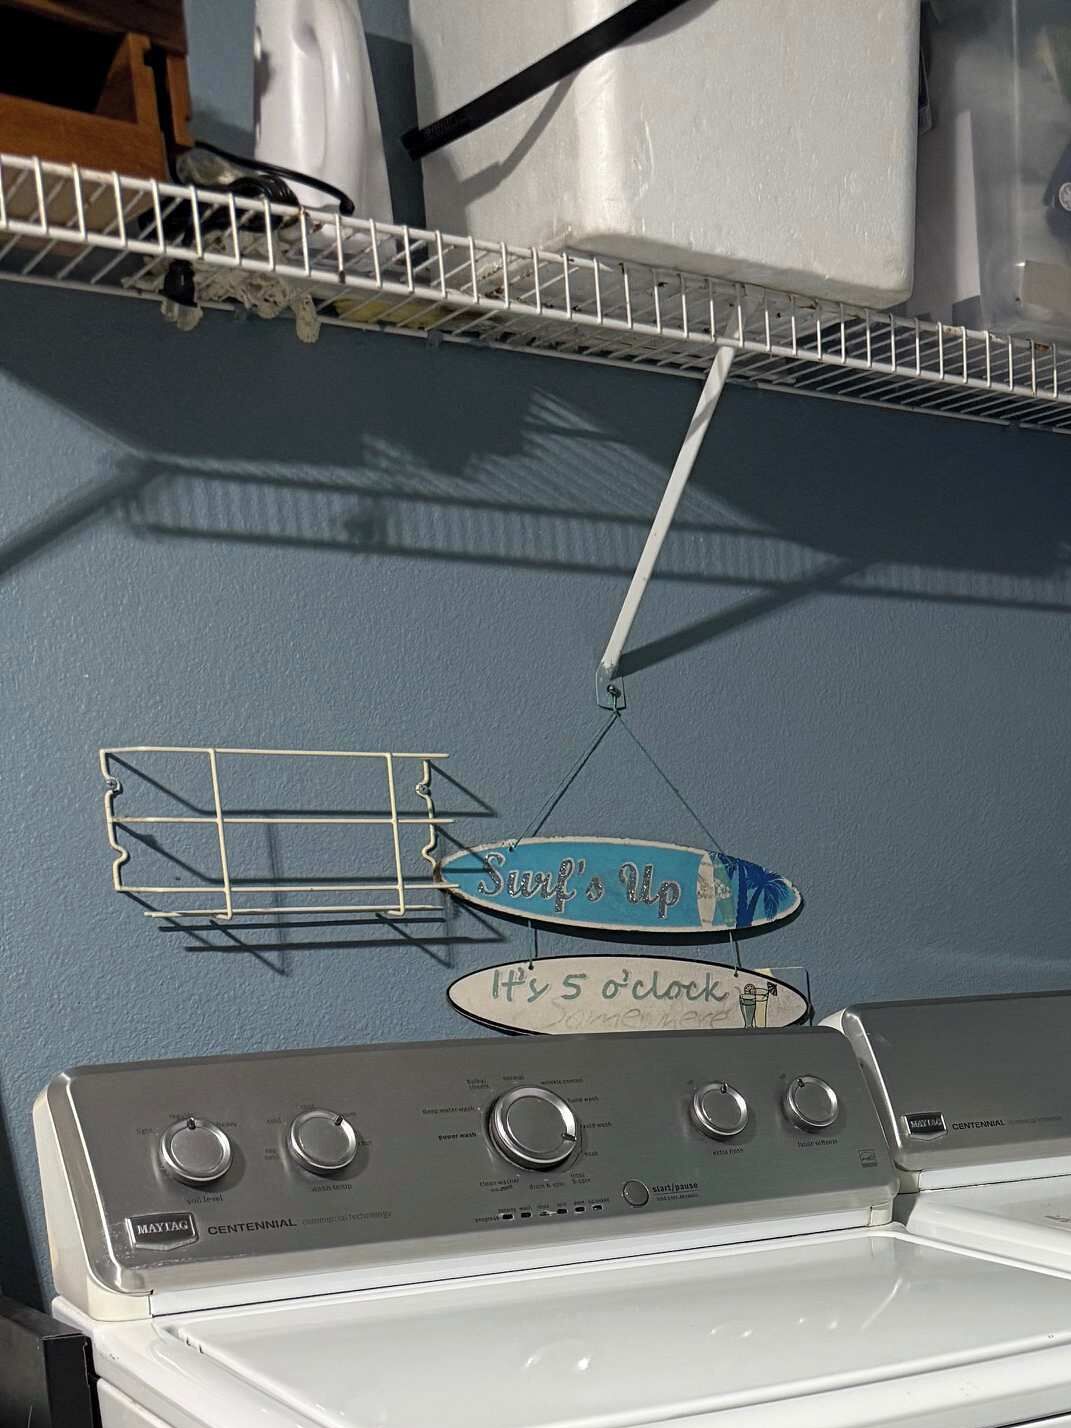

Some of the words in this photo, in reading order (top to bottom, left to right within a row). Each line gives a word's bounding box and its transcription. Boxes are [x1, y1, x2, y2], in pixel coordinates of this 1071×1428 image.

[478, 853, 604, 913] Surf's
[619, 861, 682, 919] Up
[491, 967, 550, 1003] It's
[560, 972, 588, 1001] 5
[601, 968, 729, 1002] o'clock
[952, 1119, 1007, 1131] CENTENNIAL
[652, 1181, 699, 1194] start/pause
[137, 1220, 189, 1236] MAYTAG
[207, 1217, 298, 1236] CENTENNIAL
